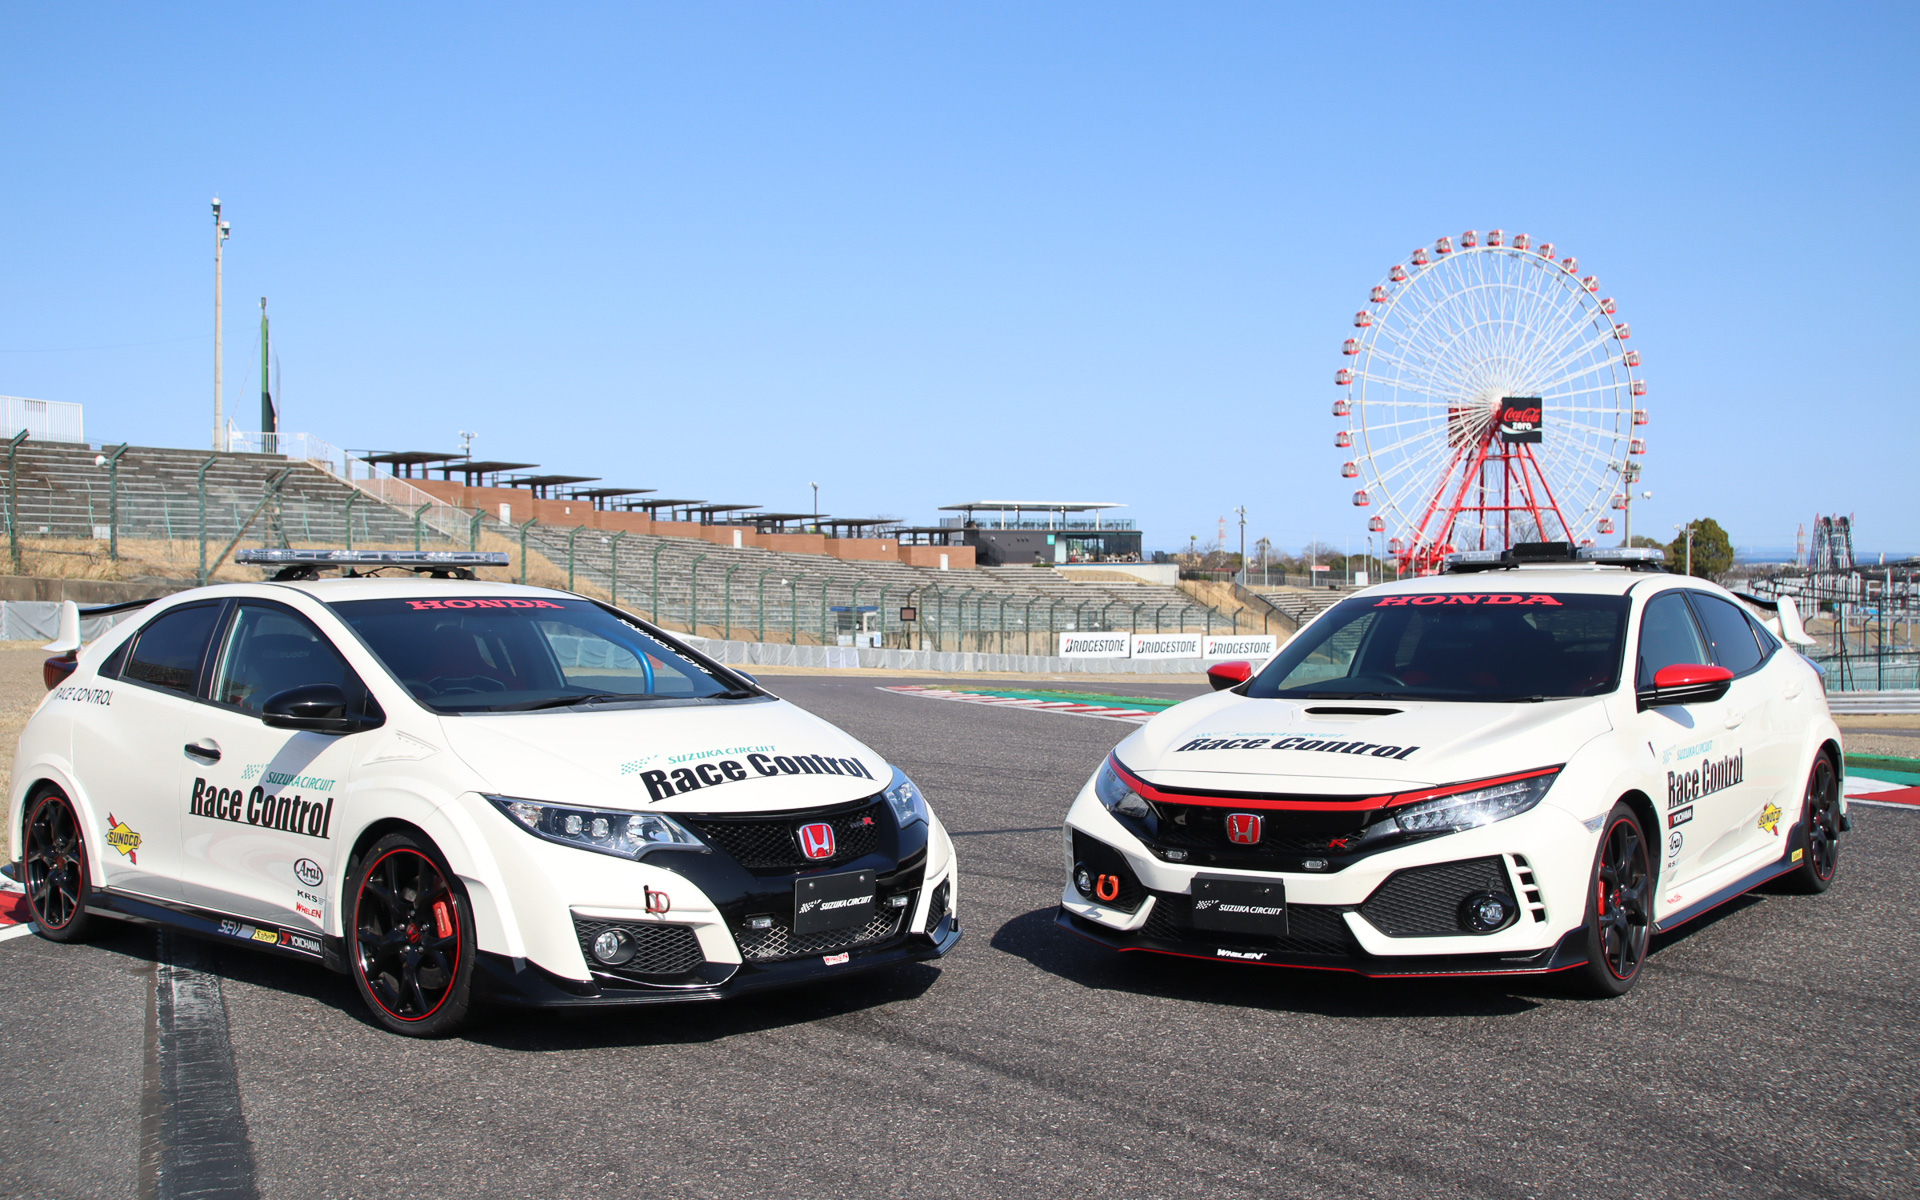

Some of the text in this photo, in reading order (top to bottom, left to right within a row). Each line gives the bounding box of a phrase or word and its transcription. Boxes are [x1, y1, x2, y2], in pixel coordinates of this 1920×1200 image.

[1512, 422, 1532, 430] zero
[405, 600, 566, 610] HONDA
[1373, 594, 1563, 607] HONDA
[616, 618, 713, 675] RACE CONTROL
[1065, 638, 1125, 653] BRIDGESTONE
[1137, 640, 1196, 654] BRIDGESTONE
[1209, 641, 1271, 655] BRIDGESTONE
[72, 687, 113, 706] CONTROL
[668, 745, 776, 764] SUZUKA CIRCUIT
[1175, 737, 1421, 761] Race Control
[266, 771, 336, 792] SUZUKA CIRCUIT
[639, 753, 876, 803] Race Control
[1667, 747, 1743, 810] Race Control
[190, 777, 334, 838] Race Control
[1758, 810, 1781, 826] SUNOCO
[108, 831, 139, 847] SUNOCO
[296, 860, 320, 881] Arai
[297, 889, 318, 903] KRS
[820, 894, 874, 911] SUZUKA CIRCUIT
[1218, 904, 1283, 916] SUZUKA CIRCUIT
[218, 919, 241, 936] SEV
[291, 935, 321, 953] YOKOHAMA
[1216, 948, 1264, 961] WHELEN
